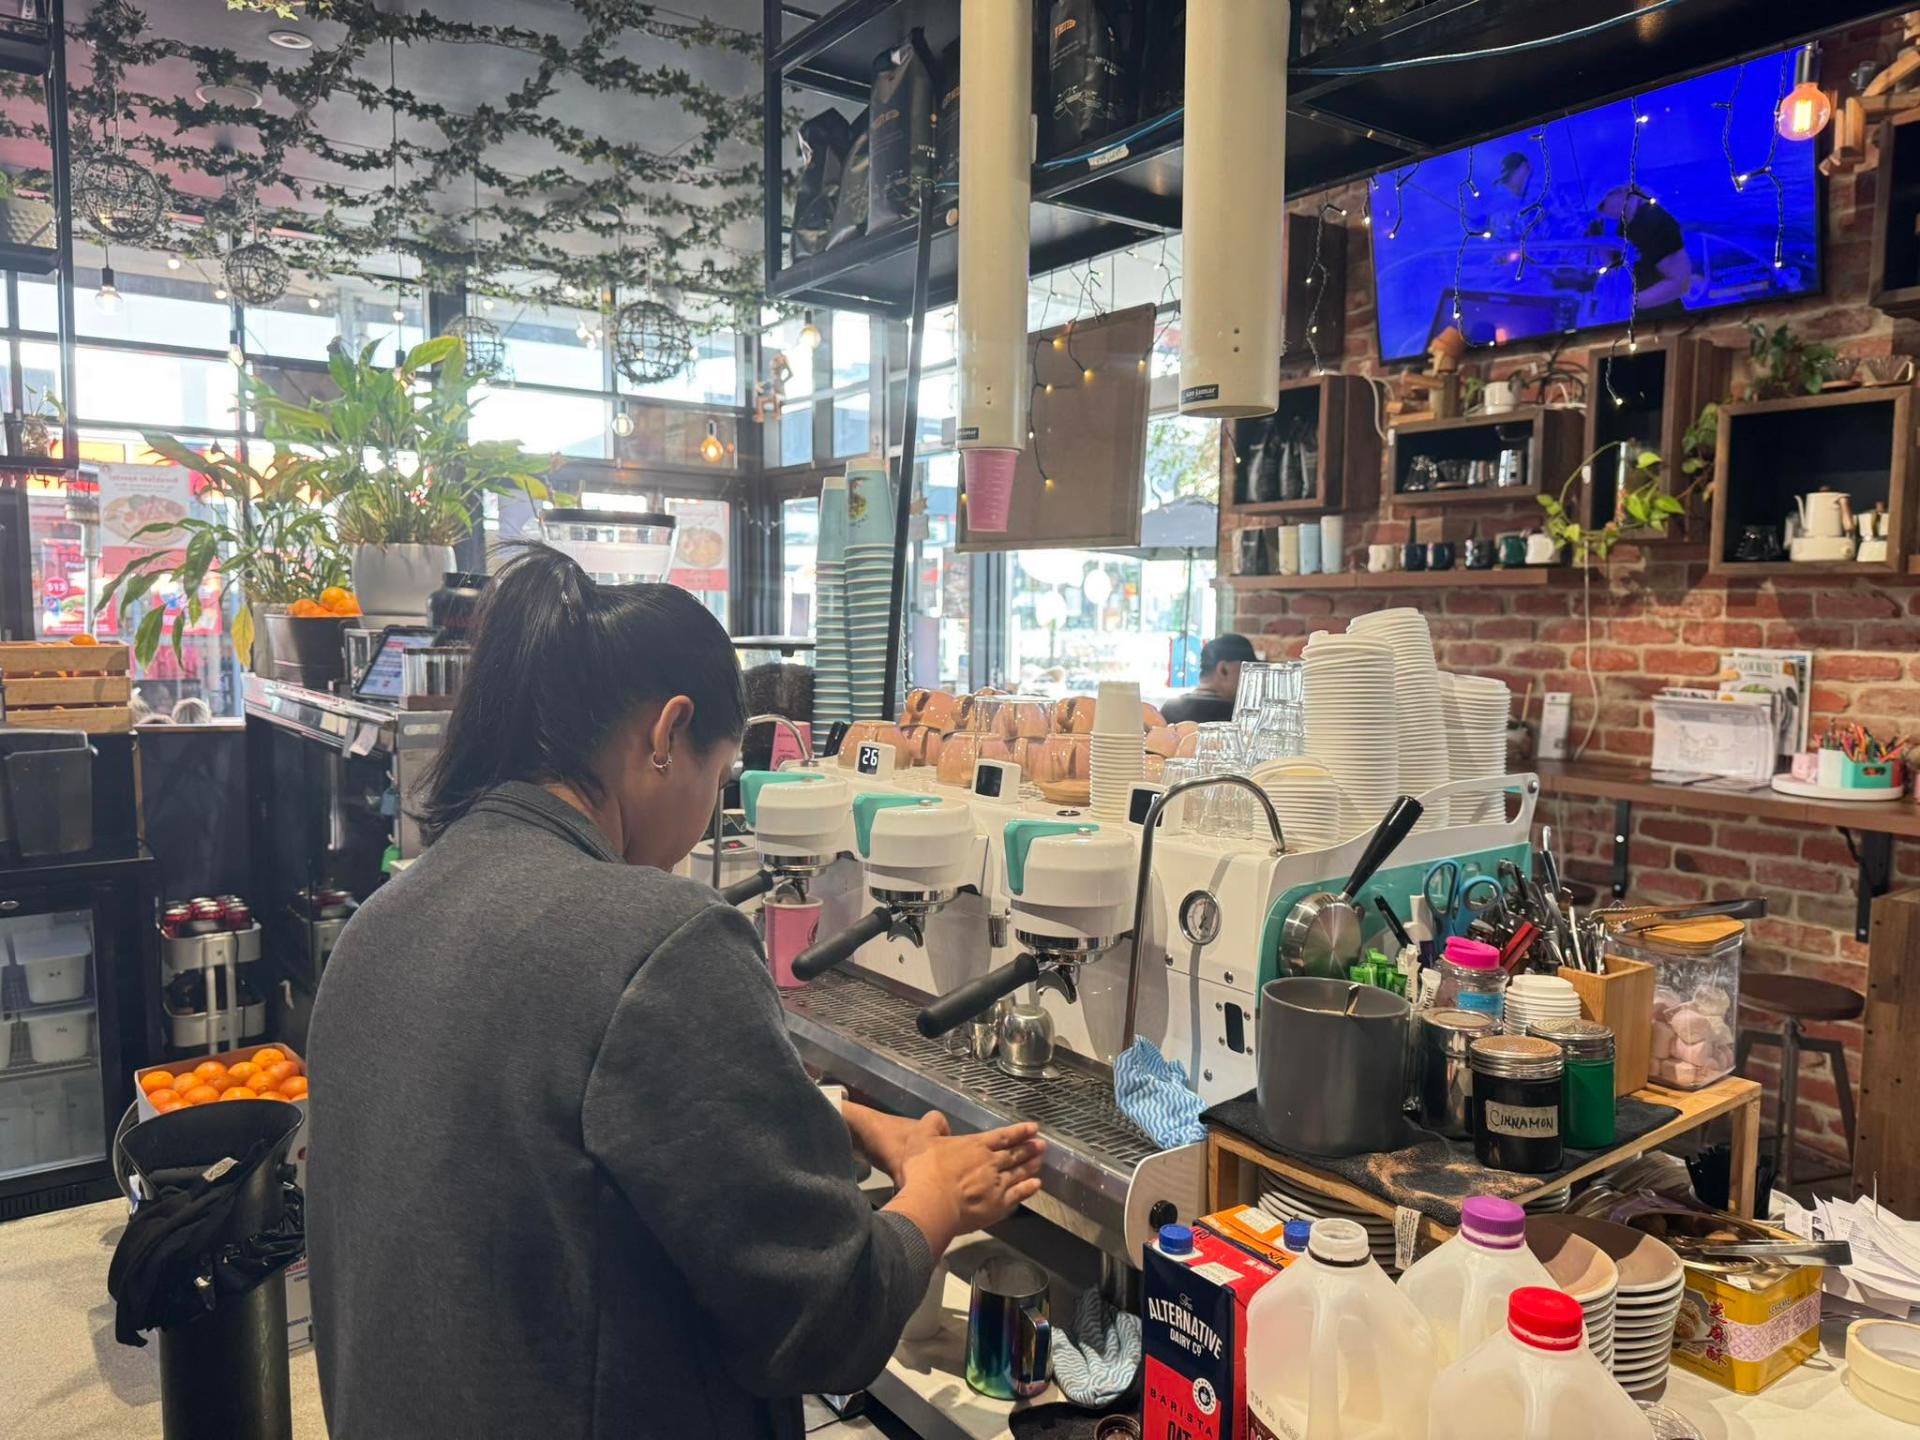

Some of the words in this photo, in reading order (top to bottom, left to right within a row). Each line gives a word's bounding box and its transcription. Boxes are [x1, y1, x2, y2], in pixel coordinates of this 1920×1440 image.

[862, 748, 878, 766] 26
[1490, 1109, 1553, 1130] CINNAMON
[1147, 1297, 1223, 1360] ALTERNATIVE
[1169, 1328, 1191, 1350] DAIRY
[1150, 1387, 1214, 1438] BARISTA
